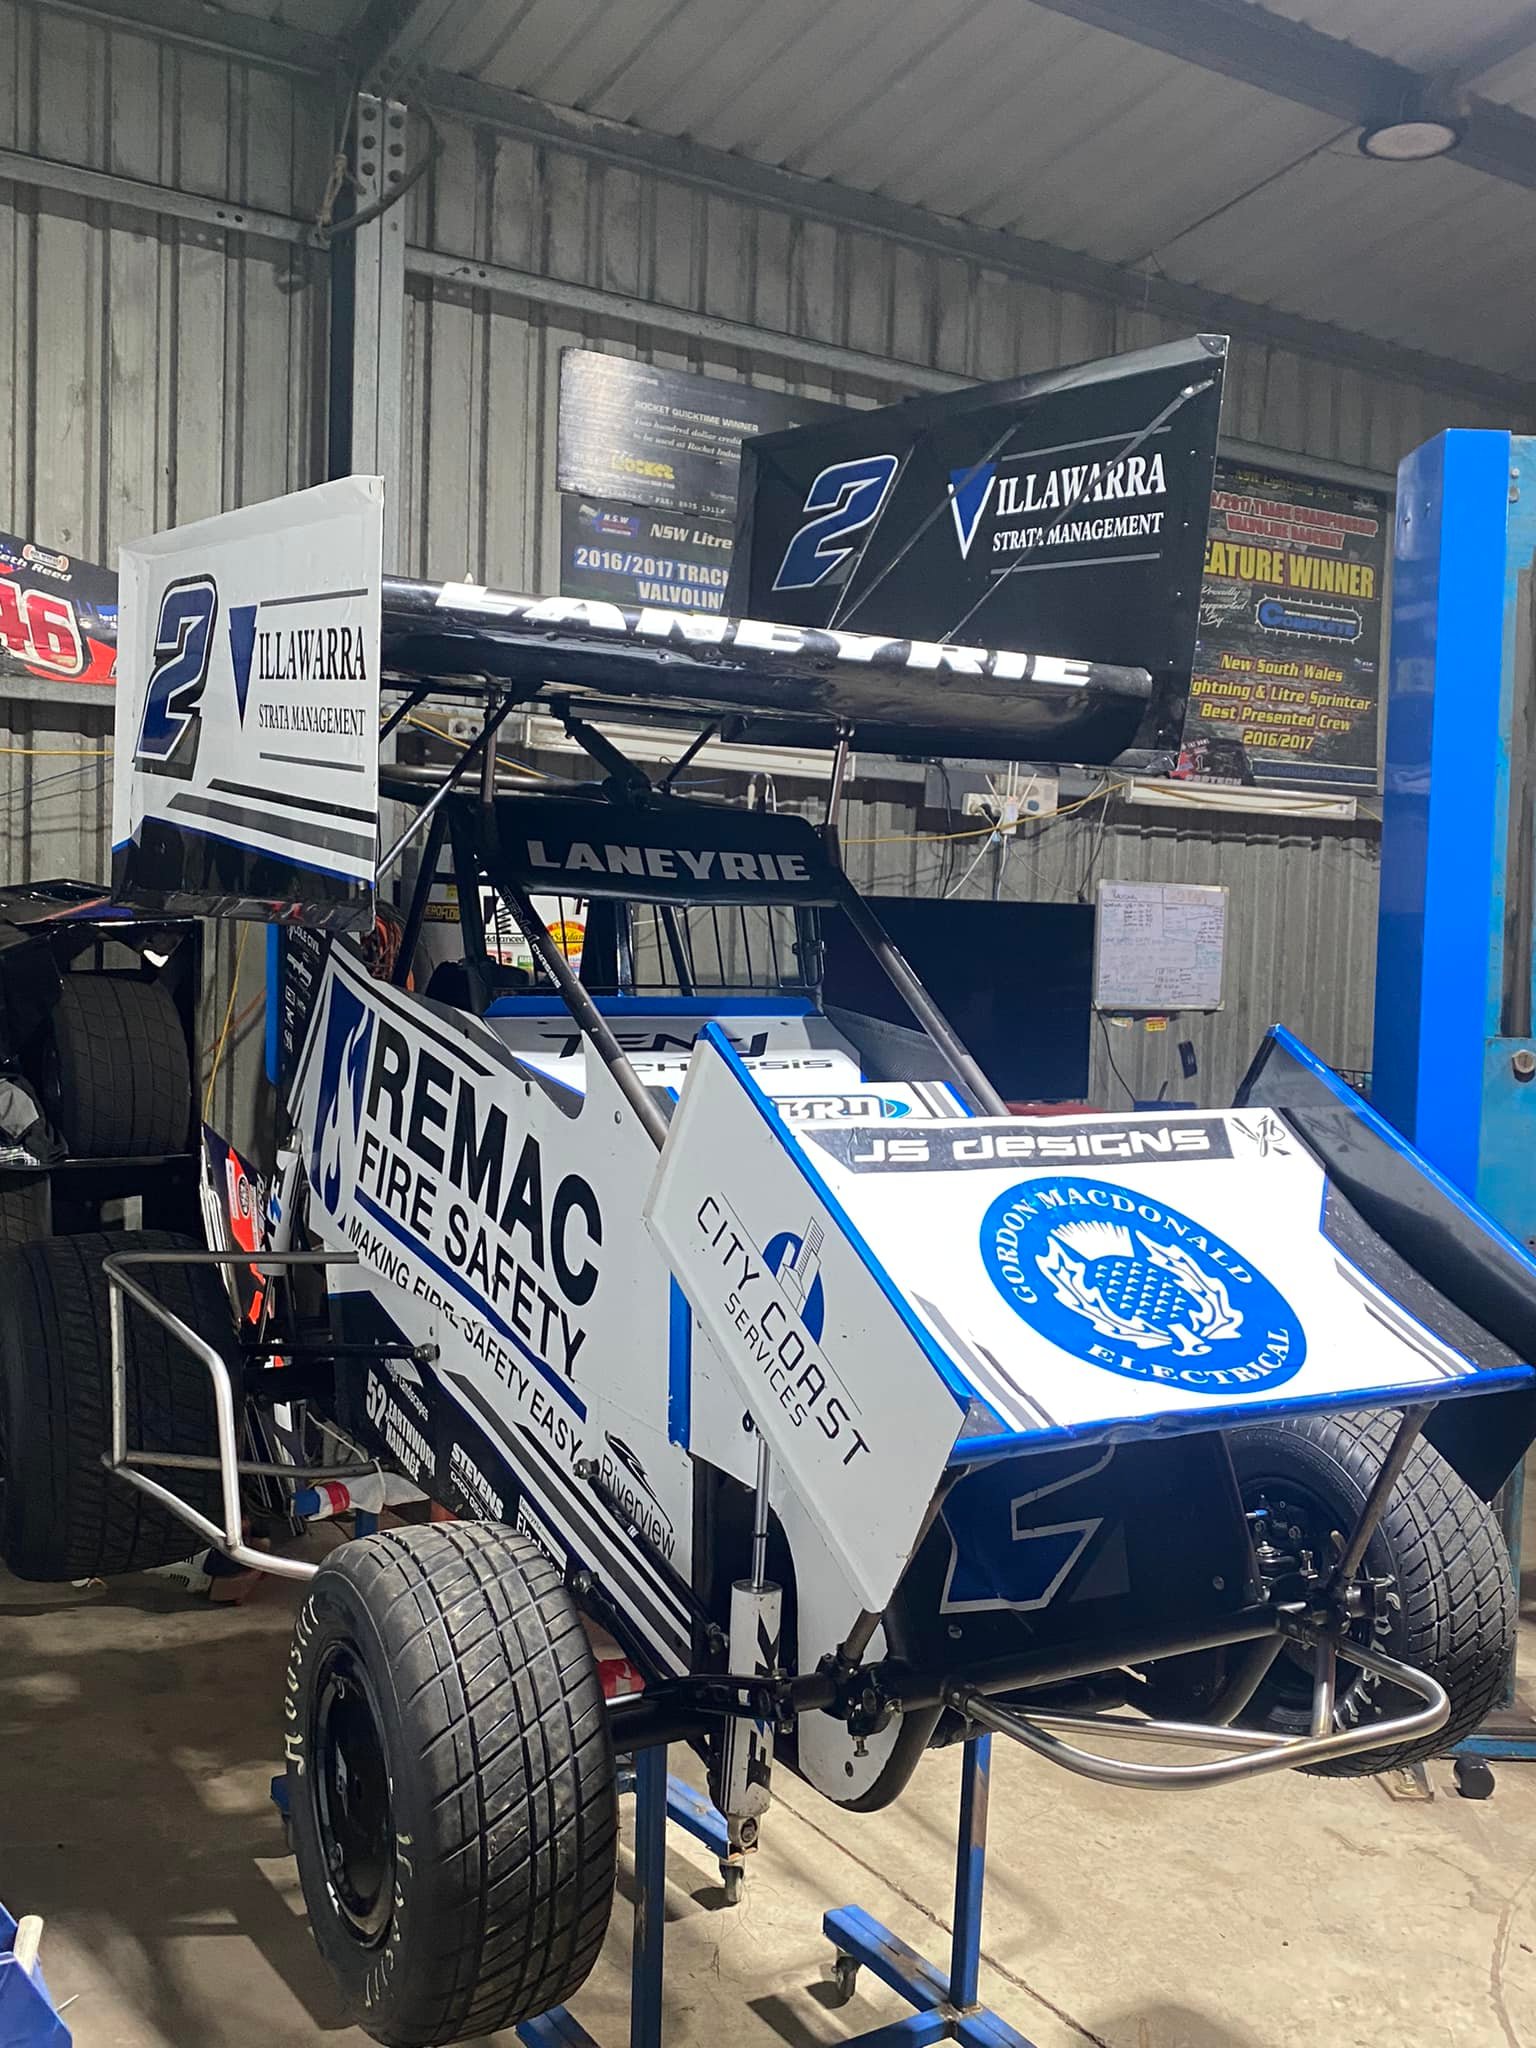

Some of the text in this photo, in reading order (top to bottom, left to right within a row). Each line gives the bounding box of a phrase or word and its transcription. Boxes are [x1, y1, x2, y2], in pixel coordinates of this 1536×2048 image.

[672, 408, 720, 426] QUICKTIME
[722, 417, 759, 433] WINNER
[650, 523, 690, 543] NSW
[692, 531, 734, 550] Litre
[772, 453, 898, 592] 2
[993, 512, 1164, 552] STRATA MANAGEMENT
[31, 562, 73, 582] Reed
[577, 548, 674, 579] 2016/2017
[1288, 554, 1375, 598] WINNER
[0, 577, 84, 675] 46
[1201, 600, 1249, 614] upported
[258, 626, 367, 682] ILLAWARRA
[433, 582, 1095, 687] LANEYRIE
[135, 574, 219, 772] 2
[1220, 654, 1250, 671] New
[1257, 659, 1299, 678] South
[1304, 665, 1344, 682] Wales
[1192, 678, 1372, 711] ghtning & Litre Sprintcar
[258, 703, 366, 737] STRATA MANAGEMENT
[1201, 703, 1351, 731] Best Presented Crew
[1243, 731, 1315, 751] 2016/2017
[526, 840, 812, 882] LANEYRIE
[484, 935, 526, 944] Adanced
[366, 1018, 603, 1306] REMAC
[854, 1138, 932, 1163] JS
[358, 1129, 437, 1242] FIRE
[444, 1203, 586, 1383] SAFETY
[996, 1186, 1254, 1305] GORDON MACDONALD
[348, 1216, 411, 1290] MAKING
[460, 1316, 530, 1403] SAFETY
[529, 1387, 584, 1464] EASY
[697, 1196, 871, 1466] CITY COAST
[724, 1292, 808, 1428] SERVICES
[1086, 1326, 1291, 1386] ELECTRICAL
[450, 1442, 504, 1520] STEVENS
[600, 1453, 676, 1561] Riverview
